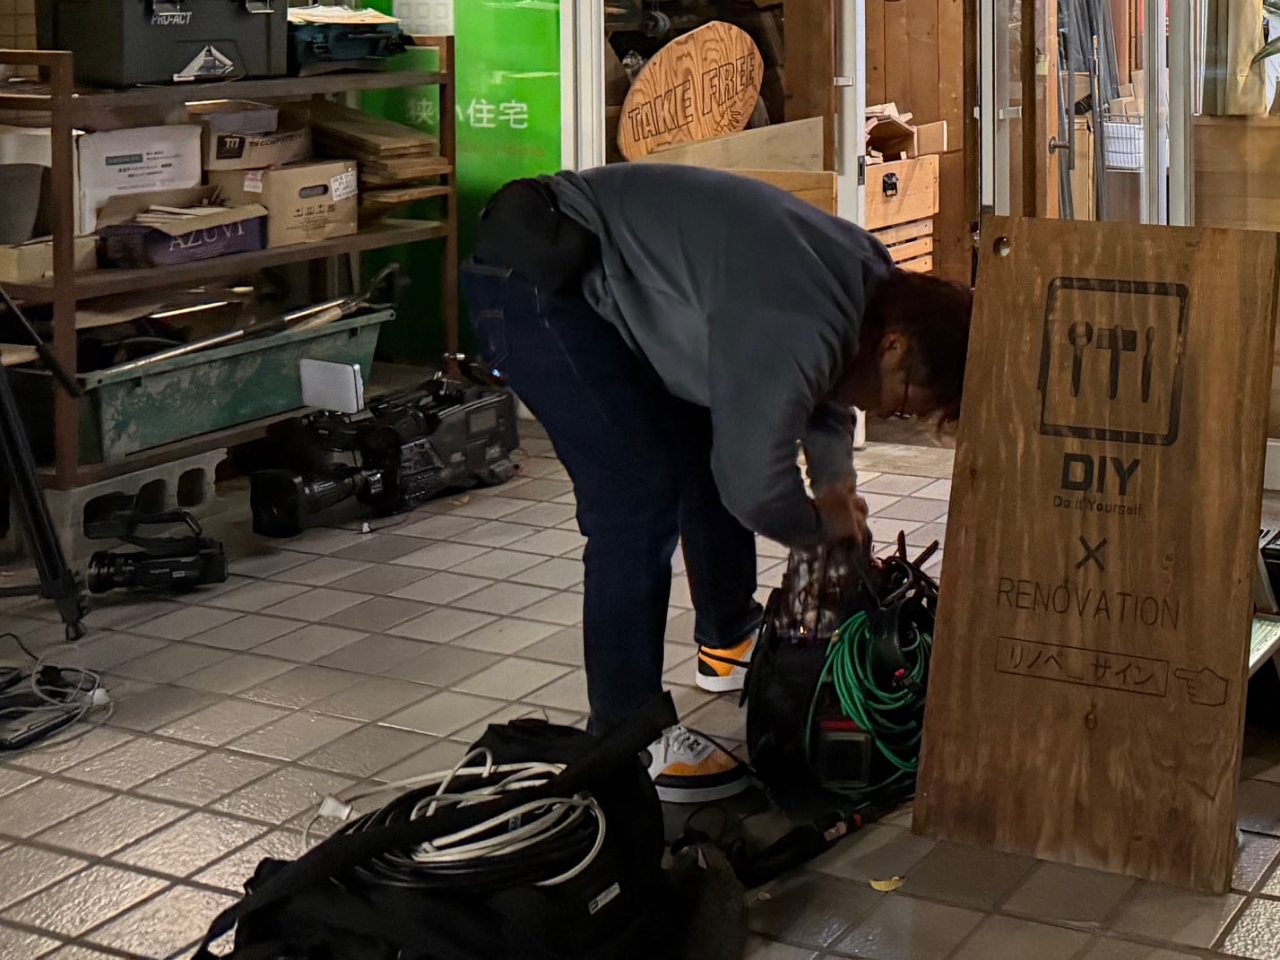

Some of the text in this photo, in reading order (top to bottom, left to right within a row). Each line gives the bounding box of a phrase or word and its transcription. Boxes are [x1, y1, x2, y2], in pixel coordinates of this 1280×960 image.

[628, 52, 756, 142] TAKE FREE
[1061, 453, 1141, 496] DIY
[1054, 496, 1071, 508] Do
[997, 577, 1179, 630] RENOVATION
